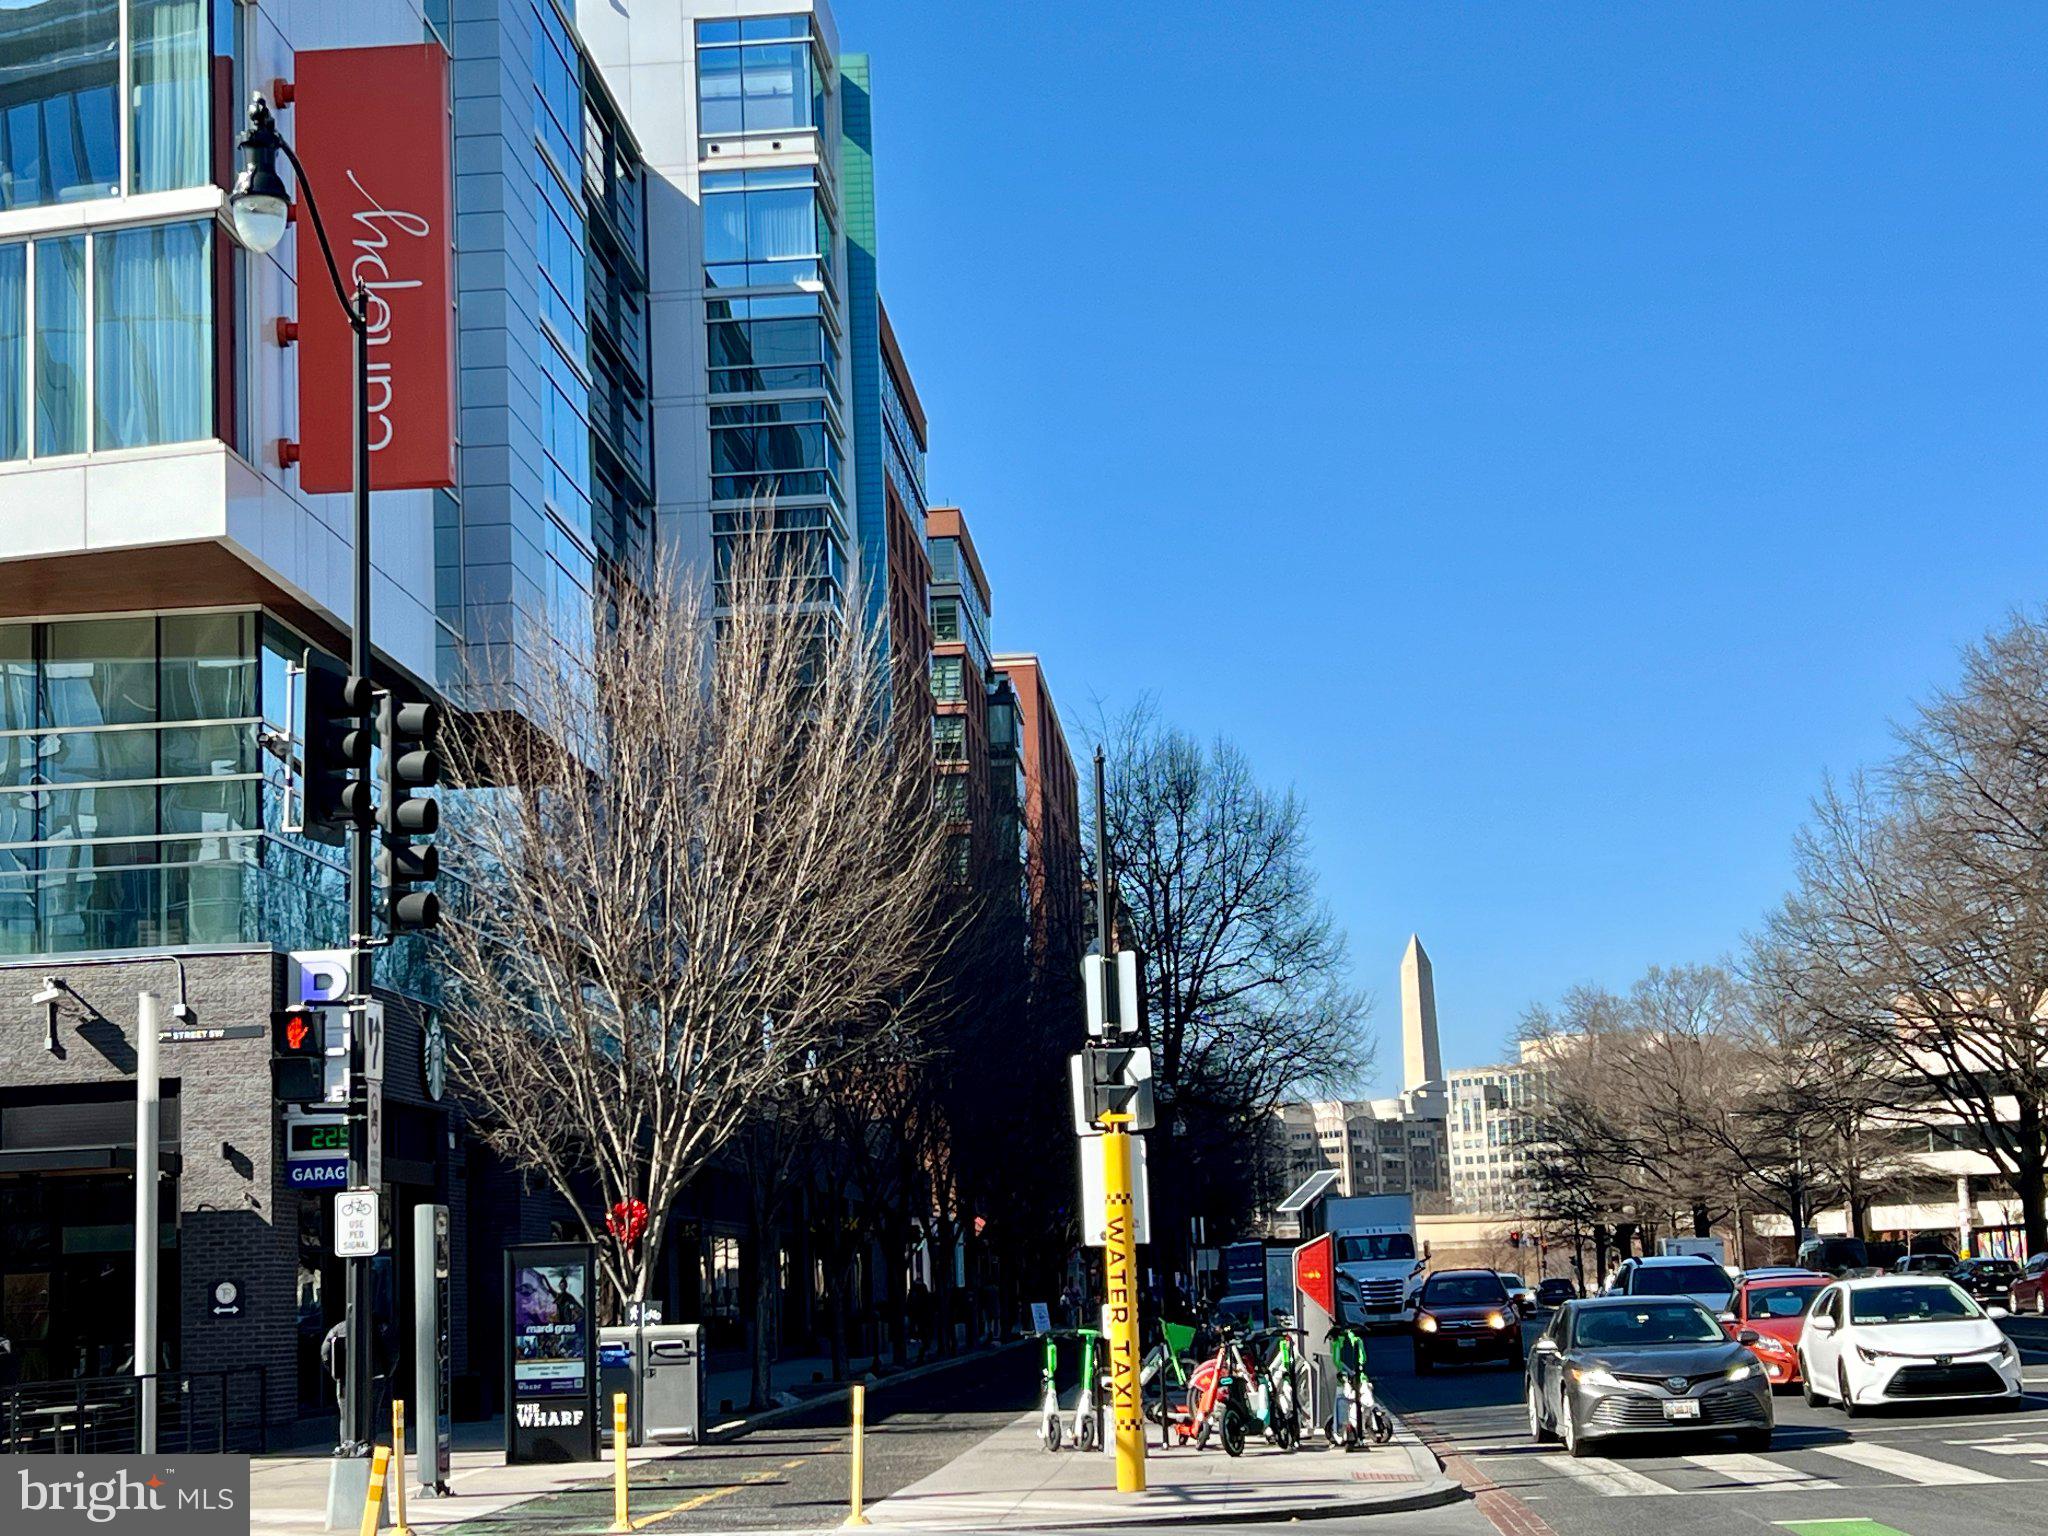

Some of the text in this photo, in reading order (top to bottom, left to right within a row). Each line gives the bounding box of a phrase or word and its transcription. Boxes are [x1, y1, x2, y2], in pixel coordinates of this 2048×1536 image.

[346, 169, 430, 451] canopy
[173, 1030, 208, 1040] STREET
[209, 1029, 225, 1038] SW
[292, 1166, 349, 1182] GARAG
[349, 1219, 364, 1229] USE
[349, 1231, 364, 1239] PED
[343, 1241, 369, 1250] SIGNAL
[1107, 1216, 1133, 1408] WATER TAXI
[526, 1323, 576, 1335] mardi gras
[516, 1403, 541, 1414] THE
[516, 1410, 584, 1428] WHARF
